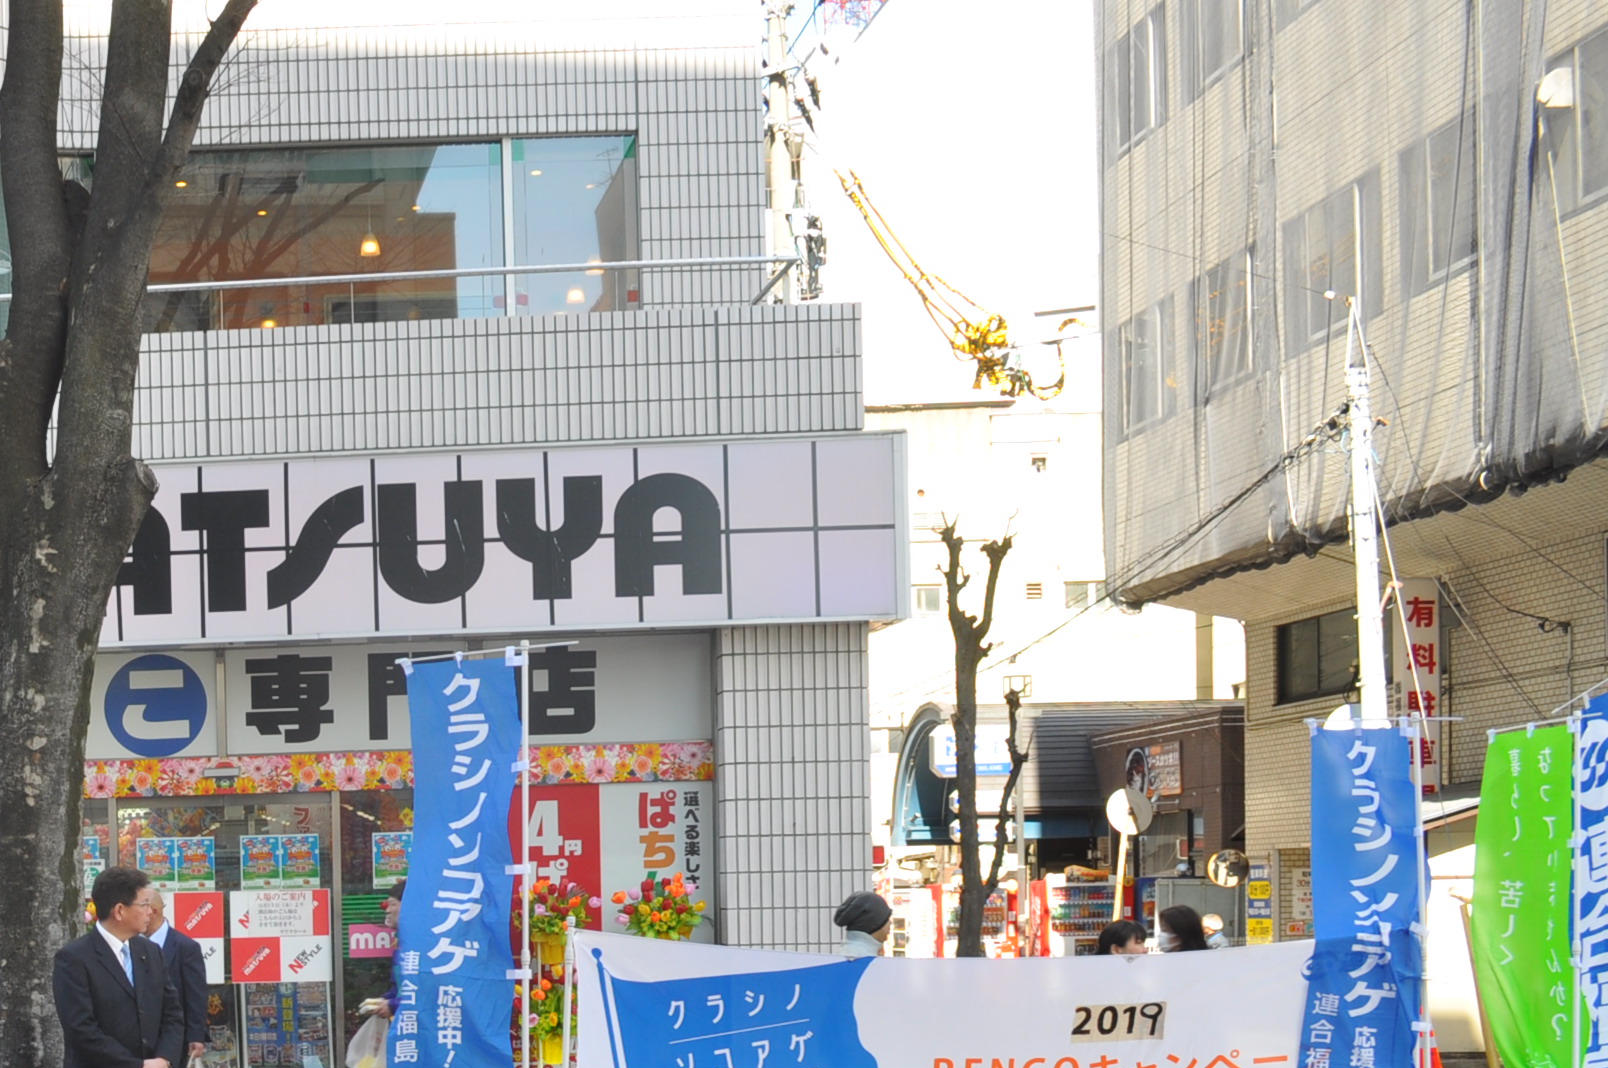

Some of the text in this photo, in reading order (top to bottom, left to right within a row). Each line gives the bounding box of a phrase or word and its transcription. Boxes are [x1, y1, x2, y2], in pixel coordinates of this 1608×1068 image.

[393, 949, 421, 1064] 連合福島
[436, 984, 464, 1068] 応援中！
[667, 984, 802, 1030] クラシノ
[1071, 1002, 1164, 1037] 2019
